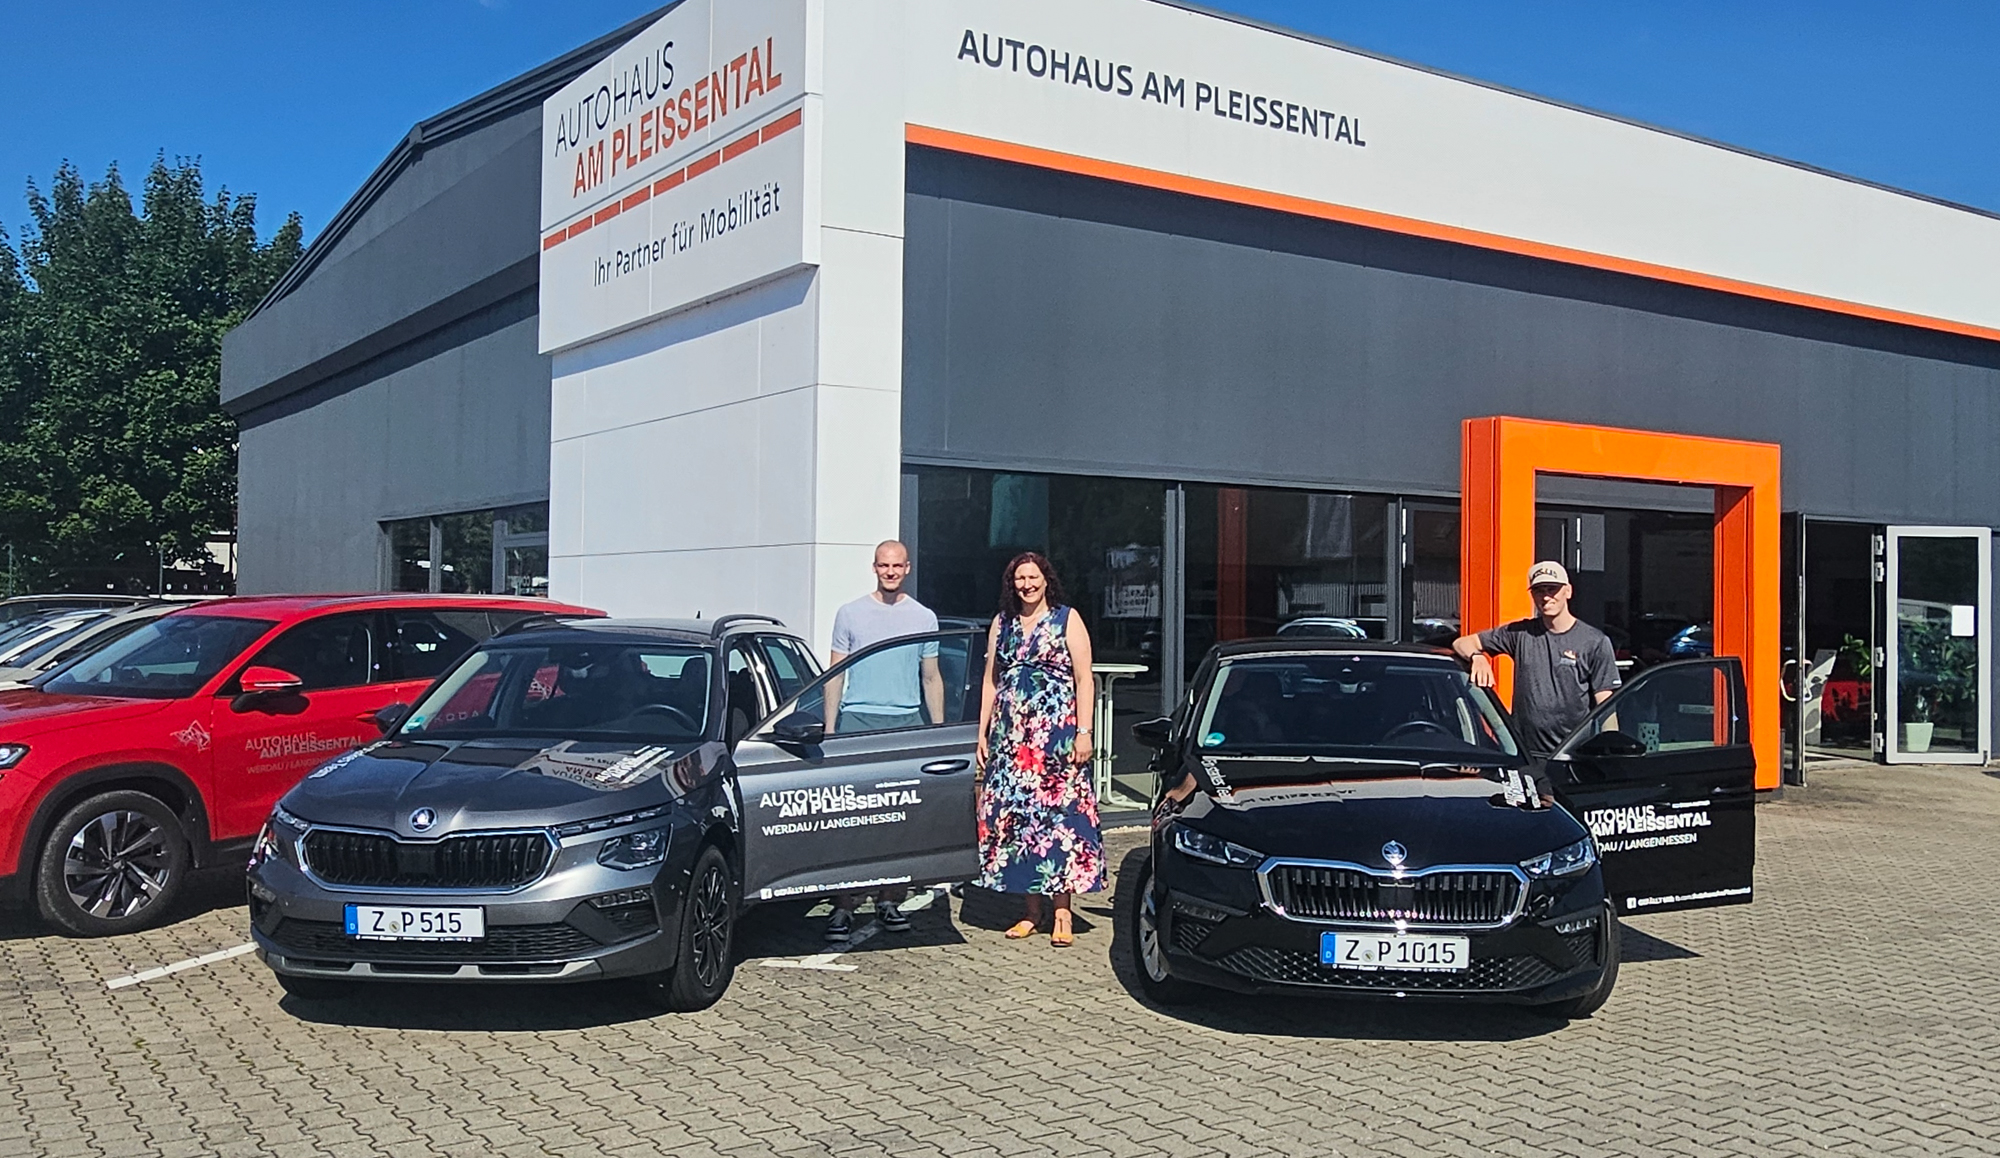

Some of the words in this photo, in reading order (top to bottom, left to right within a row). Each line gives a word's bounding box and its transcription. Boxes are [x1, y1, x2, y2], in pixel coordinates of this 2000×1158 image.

[554, 41, 674, 157] AUTOHAUS
[957, 29, 1133, 96] AUTOHAUS
[1141, 72, 1185, 108] AM
[1196, 82, 1366, 147] PLEISSENTAL
[573, 140, 604, 198] AM
[612, 37, 782, 177] PLEISSENTAL
[594, 256, 611, 287] Ihr
[616, 237, 666, 277] Partner
[672, 221, 695, 253] für
[700, 182, 780, 243] Mobilität
[245, 732, 317, 751] AUTOHAUS
[260, 746, 281, 759] AM
[246, 761, 284, 775] WERDAU
[760, 785, 855, 808] AUTOHAUS
[779, 803, 807, 818] AM
[811, 790, 922, 814] PLEISSENTAL
[762, 822, 812, 836] WERDAU
[820, 811, 906, 829] LANGENHESSEN
[1584, 804, 1655, 826] UTOHAUS
[1591, 822, 1615, 836] AM
[1617, 811, 1711, 834] PLEISSENTAL
[1598, 841, 1617, 852] DAU
[1625, 833, 1697, 850] LANGENHESSEN
[372, 911, 385, 932] Z
[401, 911, 414, 932] P
[420, 912, 461, 933] 515
[1345, 940, 1360, 961] Z
[1378, 941, 1391, 961] P
[1397, 942, 1456, 964] 1015
